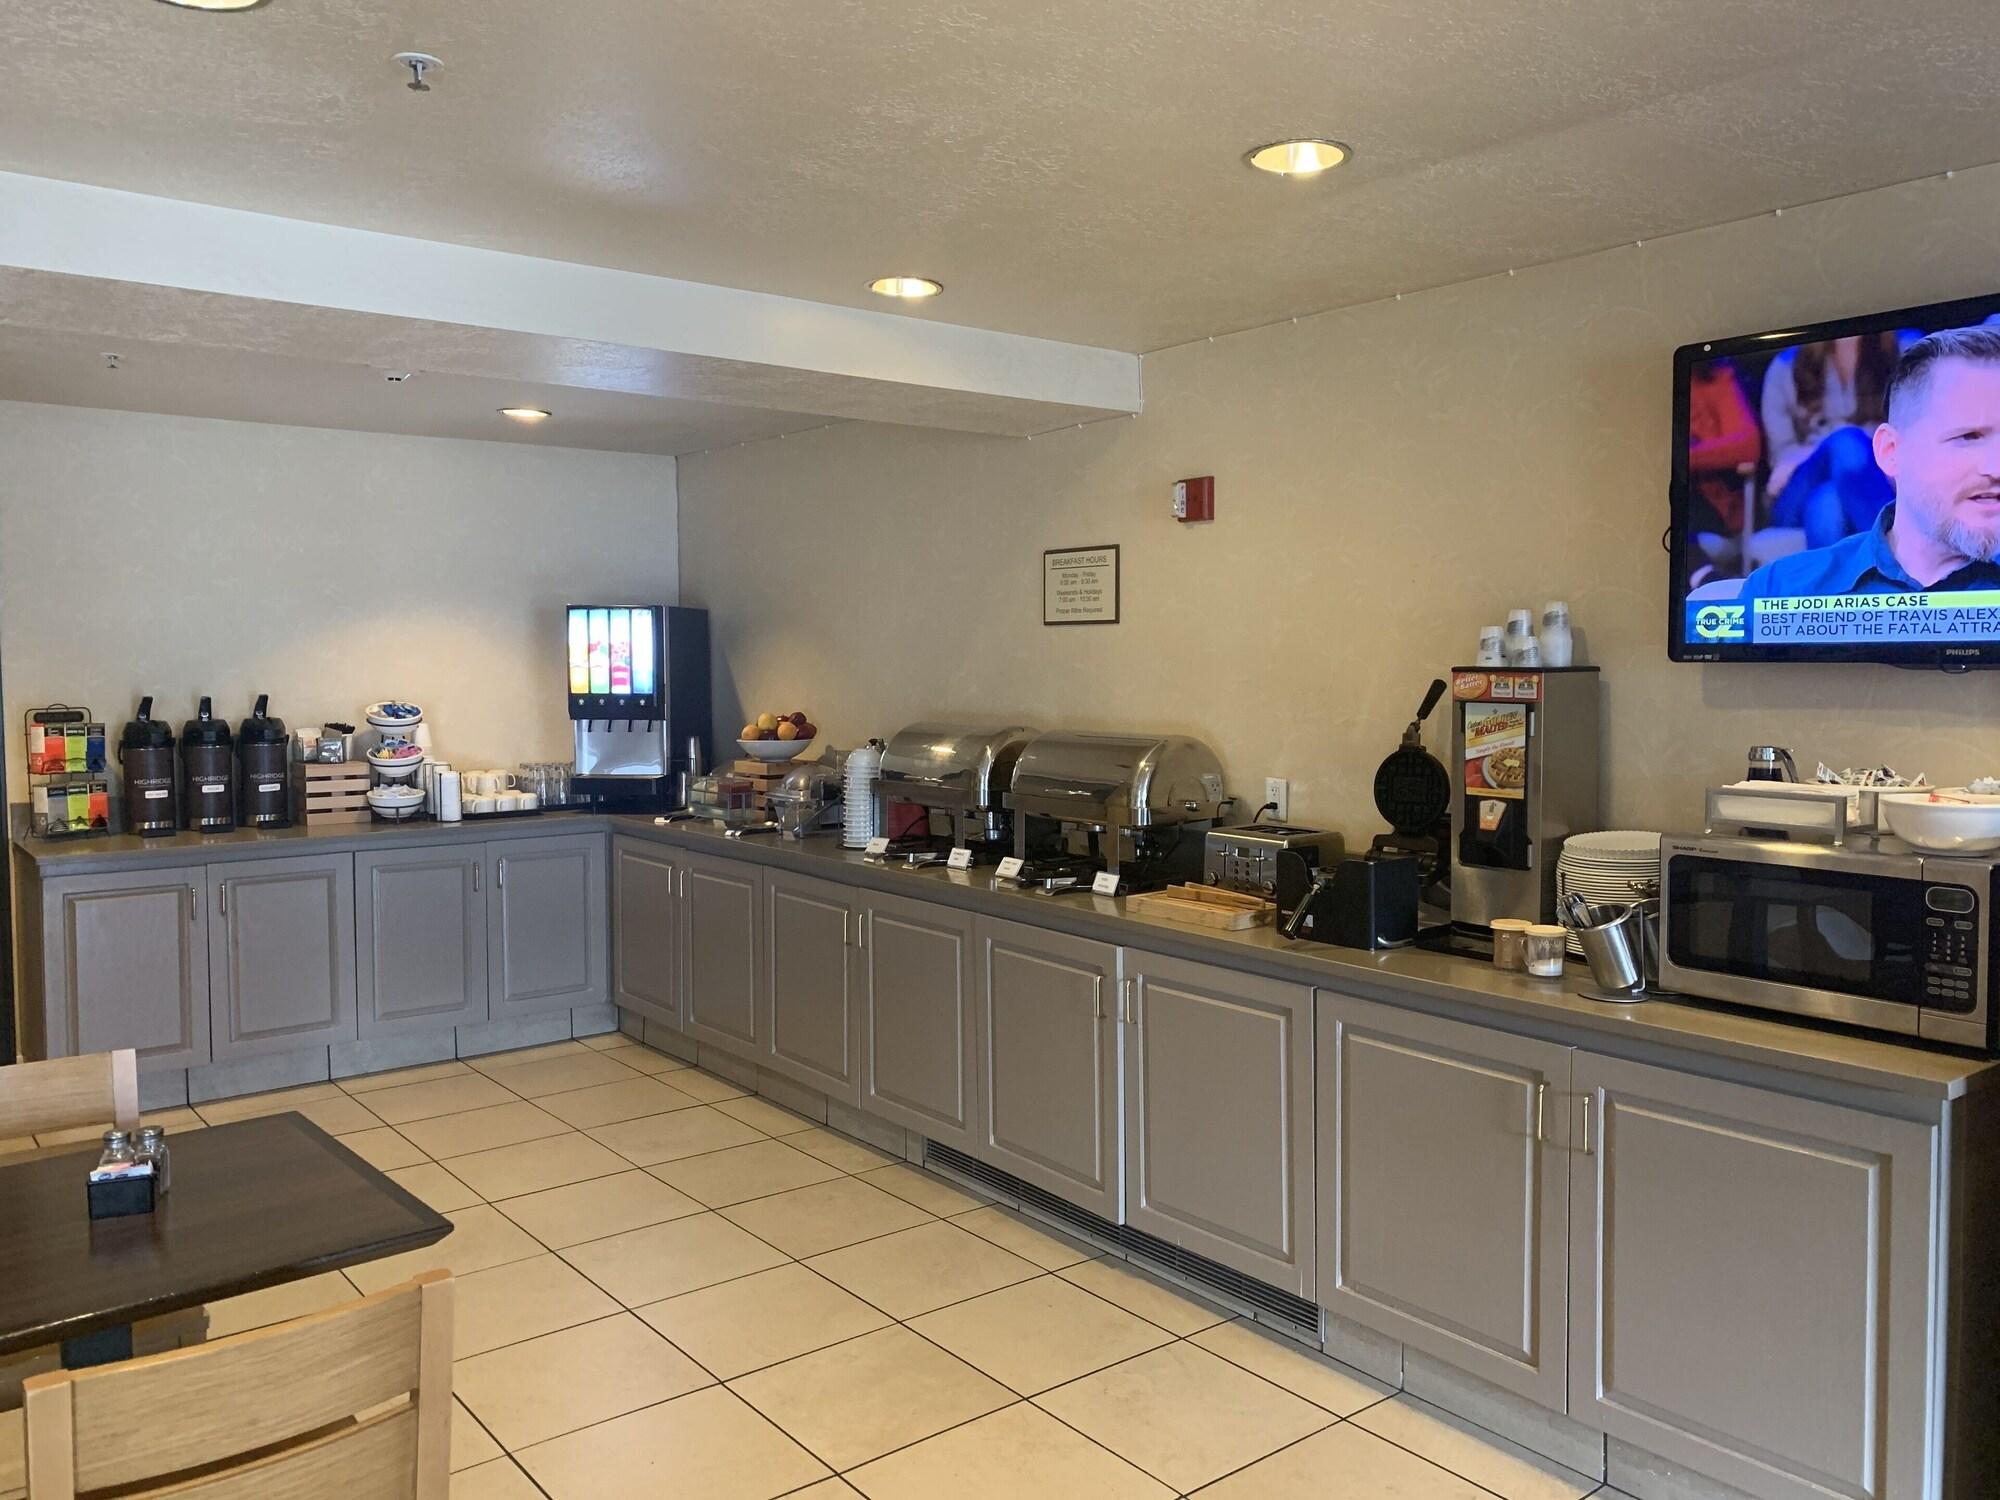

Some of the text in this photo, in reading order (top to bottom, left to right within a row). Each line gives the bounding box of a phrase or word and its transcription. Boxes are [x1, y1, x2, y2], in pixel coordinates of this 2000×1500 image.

[1052, 555, 1107, 566] BREAKFAST HOURS
[1762, 595, 1928, 610] THE JODI ARIAS CASE
[1761, 607, 2000, 624] BEST FRIEND OF TRAVIS ALEX
[1761, 625, 1791, 636] OUT
[1795, 624, 1848, 636] ABOUT
[1853, 623, 1883, 635] THE
[1888, 622, 1942, 634] FATAL
[1946, 648, 1980, 656] PHILIPS
[134, 777, 171, 785] HIGHRIDGE
[192, 774, 228, 782] HIGHRIDGE
